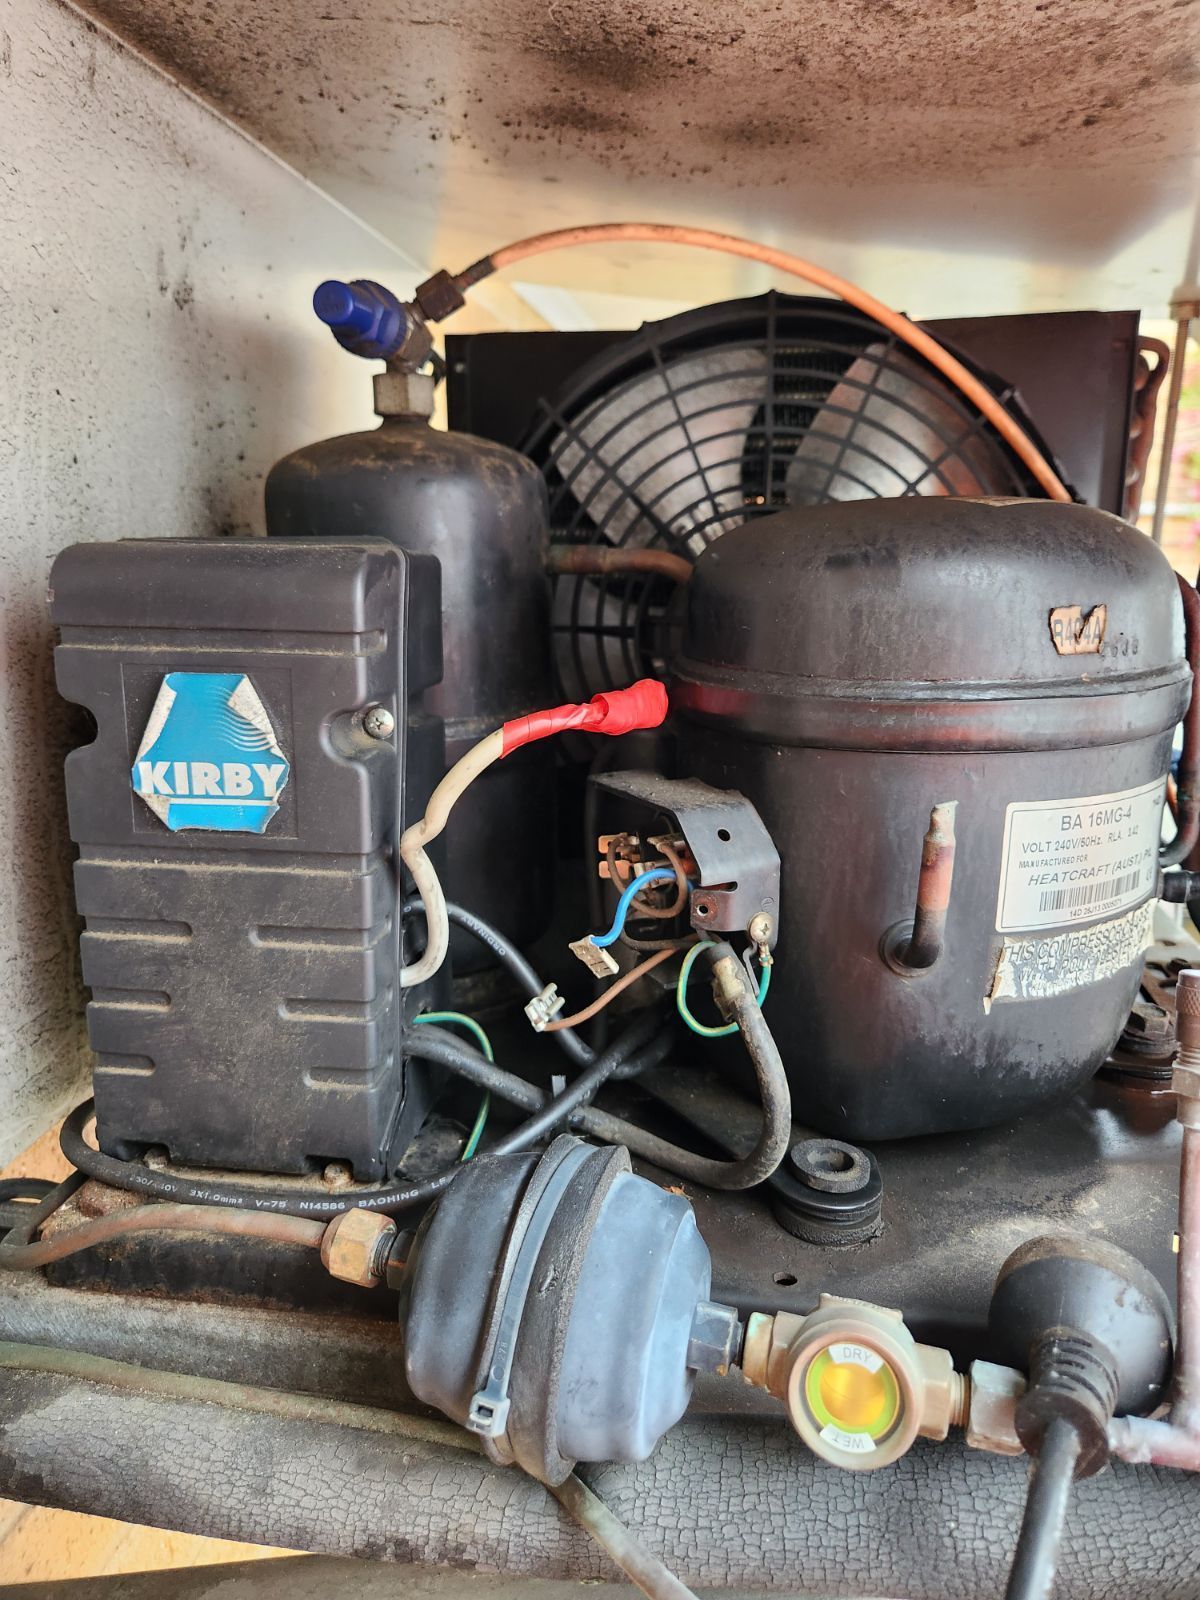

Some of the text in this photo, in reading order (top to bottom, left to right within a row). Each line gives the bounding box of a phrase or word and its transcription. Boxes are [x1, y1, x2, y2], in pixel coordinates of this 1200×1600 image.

[138, 761, 286, 798] KIRBY
[1061, 804, 1132, 831] BA 16MG-4
[1022, 841, 1052, 853] VOLT
[1018, 854, 1088, 868] MANUFACTURED FOR
[1028, 864, 1110, 886] HEATCRAFT
[255, 1199, 286, 1209] V-75
[299, 1201, 346, 1210] N14586
[358, 1188, 419, 1208] BAOHING
[843, 1346, 873, 1362] DRY
[832, 1431, 865, 1449] WET
